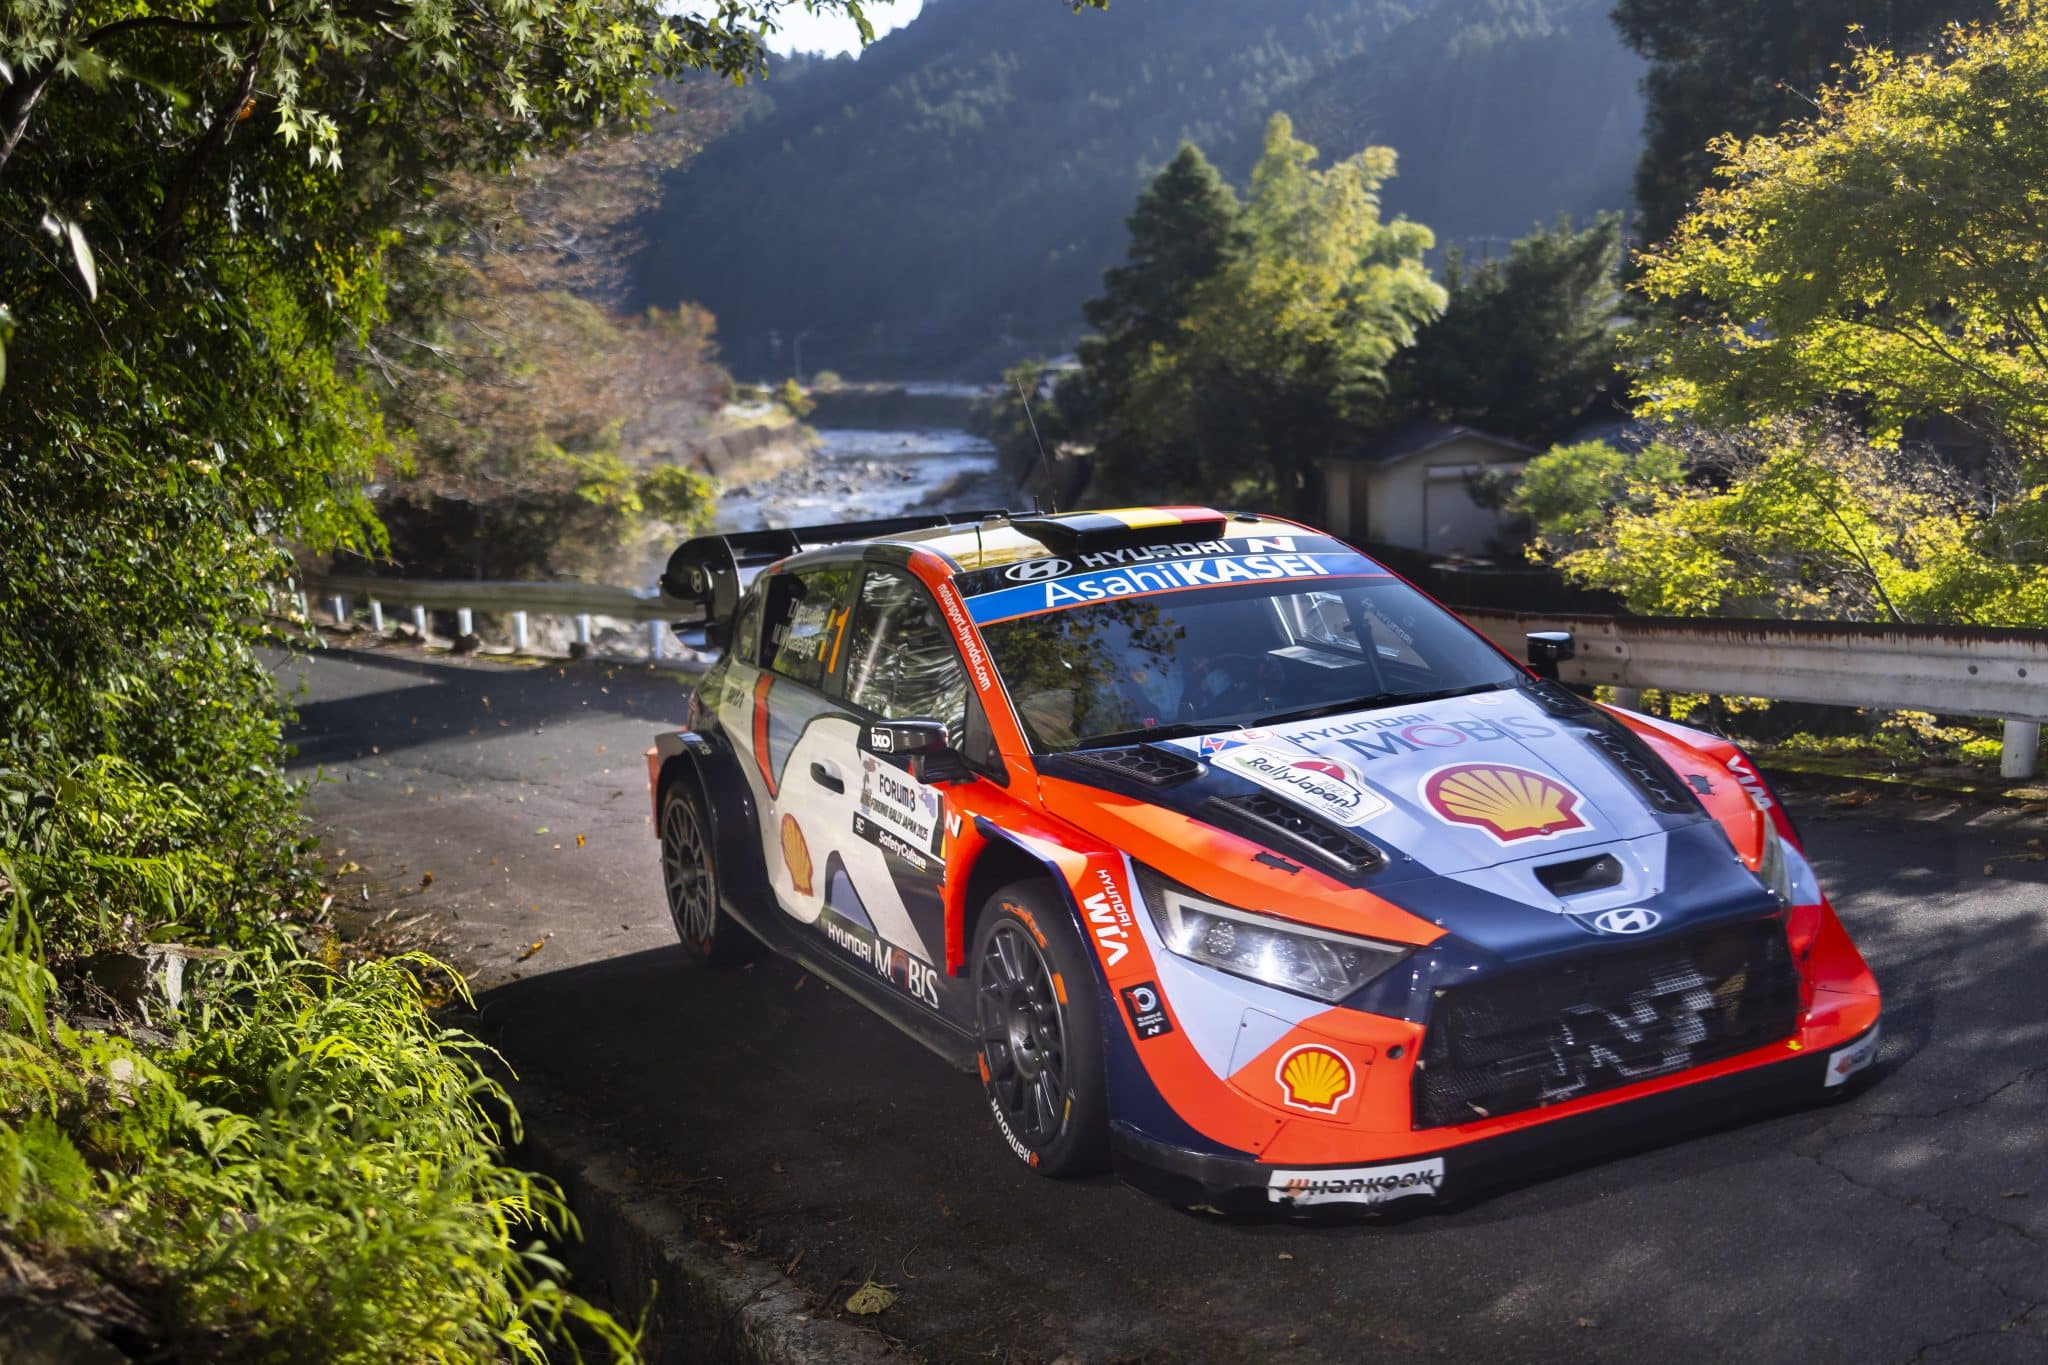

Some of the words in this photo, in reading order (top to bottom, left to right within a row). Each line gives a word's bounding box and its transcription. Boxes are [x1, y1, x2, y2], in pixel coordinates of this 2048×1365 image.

[1045, 553, 1330, 608] AsahiKASEI
[1080, 540, 1234, 568] HYUNDAI
[827, 604, 852, 674] 1
[937, 583, 992, 692] motorsport.hyundai.com
[1286, 713, 1434, 743] HYUNDAI
[1336, 716, 1557, 761] MOBIS
[879, 830, 928, 870] SafetyCulture
[1096, 869, 1134, 928] HYUNDAI
[827, 921, 872, 964] HYUNDAI
[874, 938, 940, 1010] MOBIS
